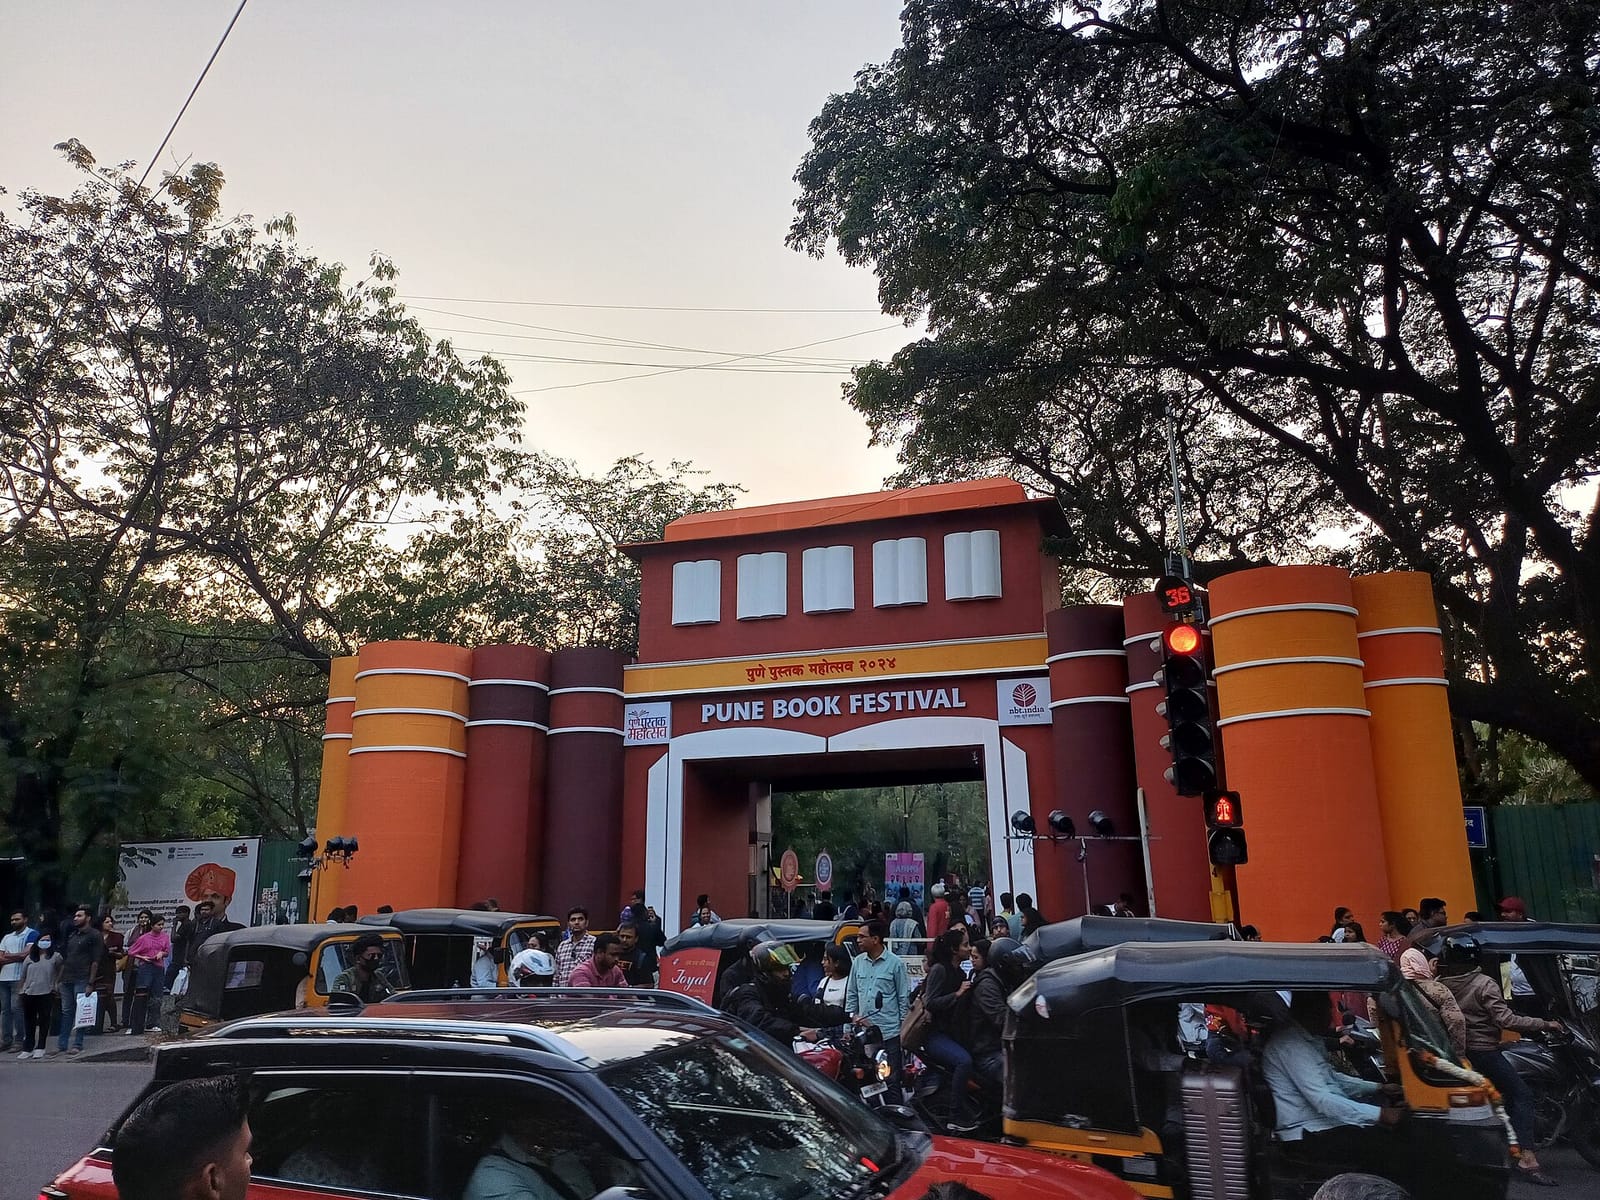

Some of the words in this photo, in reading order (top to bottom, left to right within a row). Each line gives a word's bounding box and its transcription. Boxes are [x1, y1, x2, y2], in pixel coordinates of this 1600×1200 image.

[1166, 586, 1190, 607] 36
[745, 664, 766, 682] पुणे
[768, 664, 804, 681] पुस्तक
[808, 659, 854, 676] महोत्सव
[859, 657, 896, 672] २०२४
[701, 700, 765, 723] PUNE
[772, 695, 841, 719] BOOK
[850, 687, 967, 714] FESTIVAL
[1009, 705, 1045, 714] nbt.india
